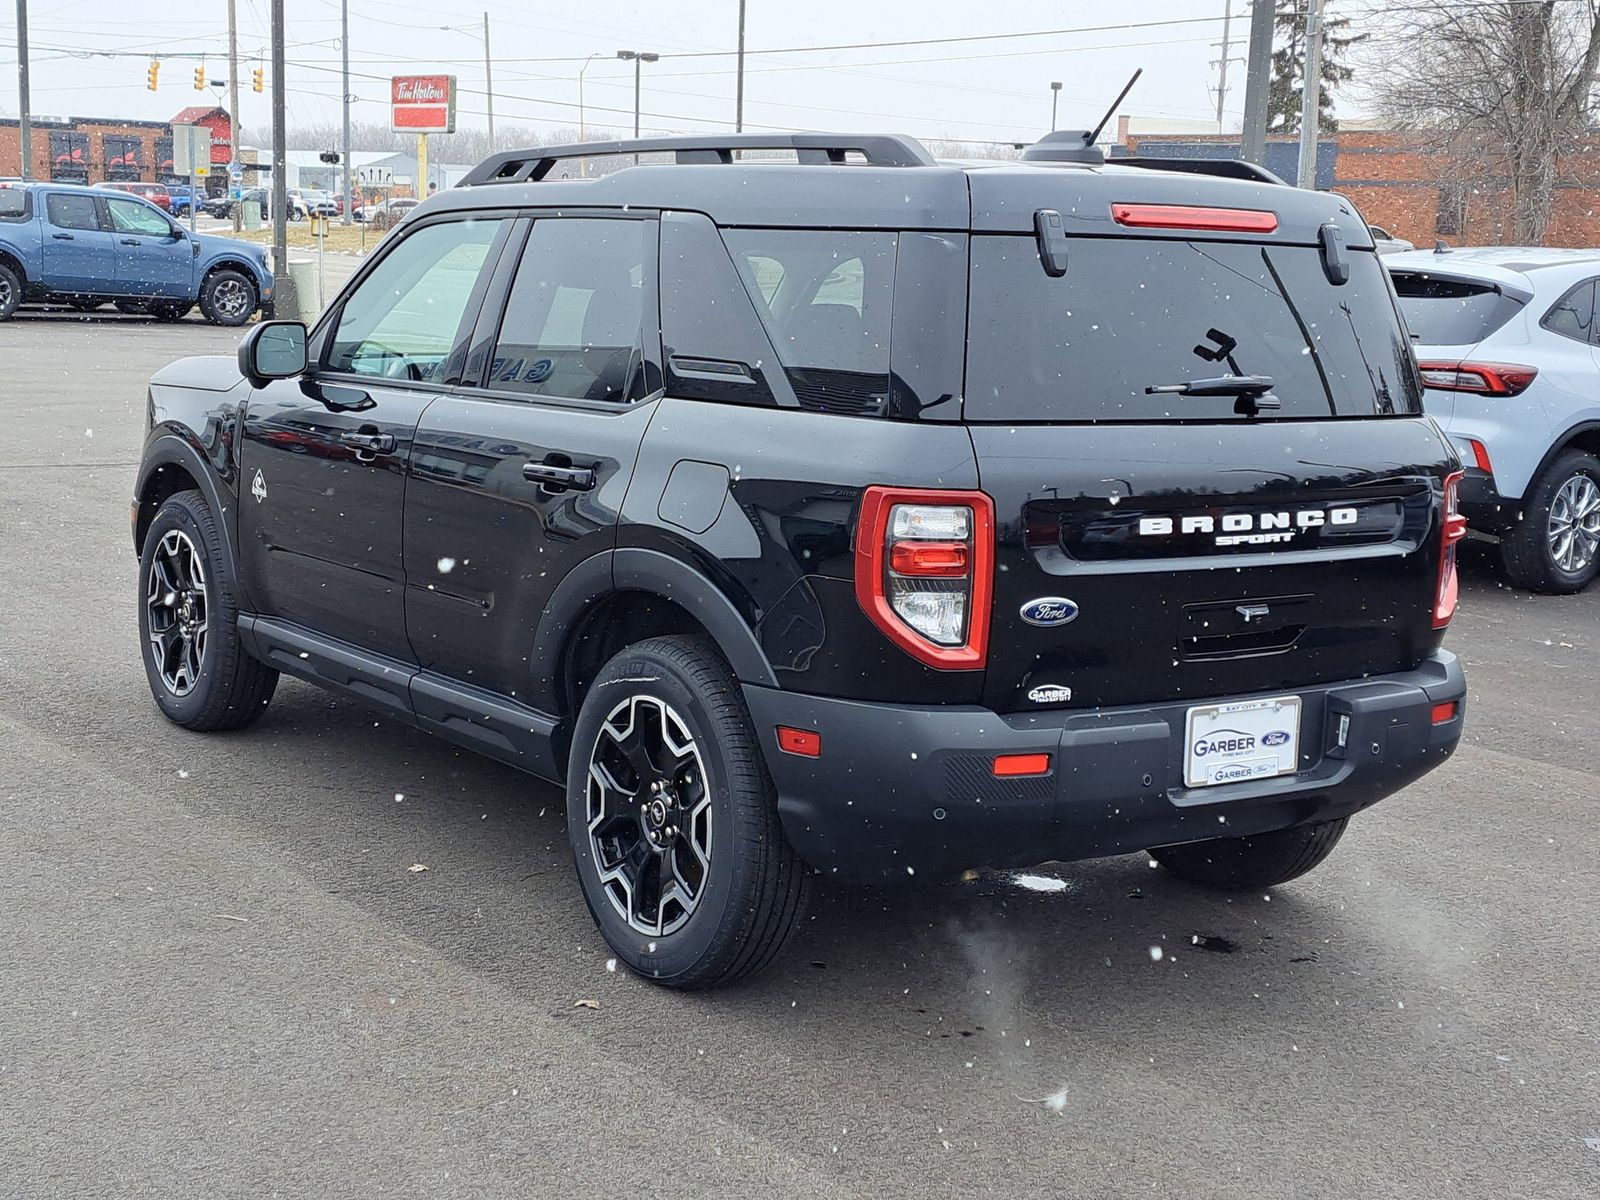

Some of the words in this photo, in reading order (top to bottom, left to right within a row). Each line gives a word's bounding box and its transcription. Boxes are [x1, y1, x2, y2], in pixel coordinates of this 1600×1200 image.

[397, 81, 412, 101] Tim
[412, 80, 444, 100] Hortons
[1139, 507, 1358, 535] BRONCO
[1215, 532, 1296, 546] SPORT
[1034, 603, 1067, 620] Ford
[1028, 689, 1072, 700] GARBER
[1266, 733, 1286, 745] Ford
[1194, 738, 1256, 756] GARBER
[1215, 769, 1252, 781] GARBER
